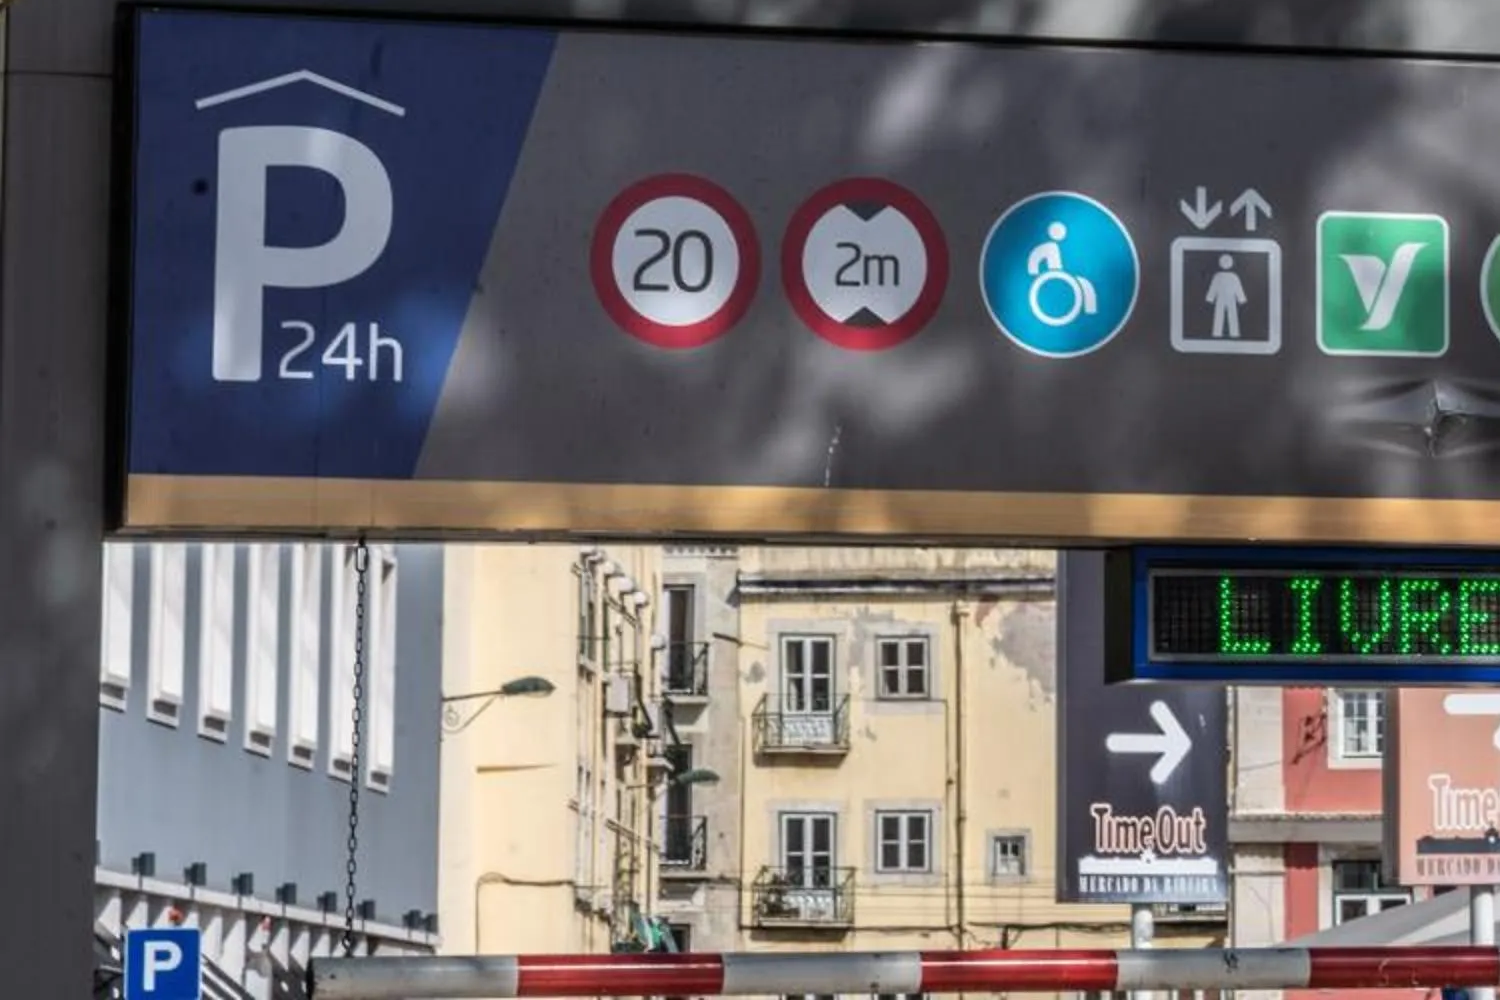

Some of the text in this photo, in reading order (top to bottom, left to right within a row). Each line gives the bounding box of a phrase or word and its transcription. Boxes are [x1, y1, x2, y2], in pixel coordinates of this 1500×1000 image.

[212, 125, 393, 382] P
[631, 228, 715, 292] 20
[834, 241, 901, 288] 2m
[279, 321, 404, 382] 24h
[143, 940, 183, 991] P
